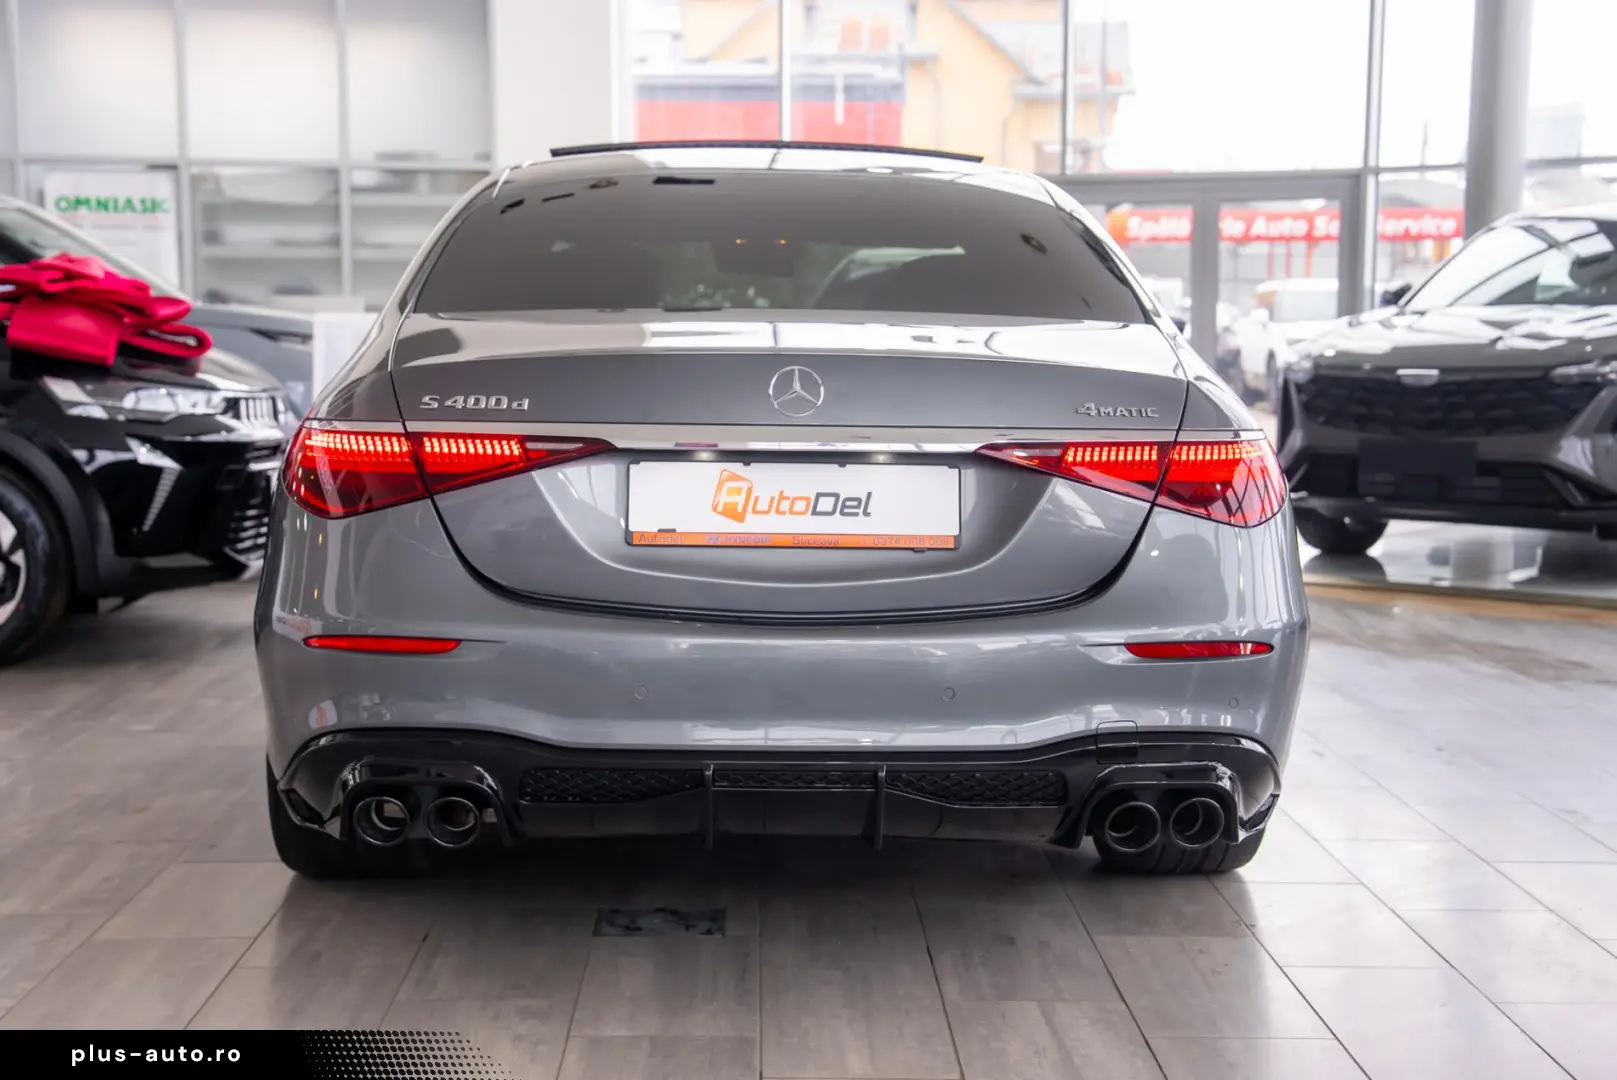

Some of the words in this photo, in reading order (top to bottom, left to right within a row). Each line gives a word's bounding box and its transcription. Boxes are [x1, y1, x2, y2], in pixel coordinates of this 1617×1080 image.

[1248, 215, 1309, 239] Auto
[1075, 402, 1160, 419] 4MATIC
[711, 468, 873, 524] AutoDel
